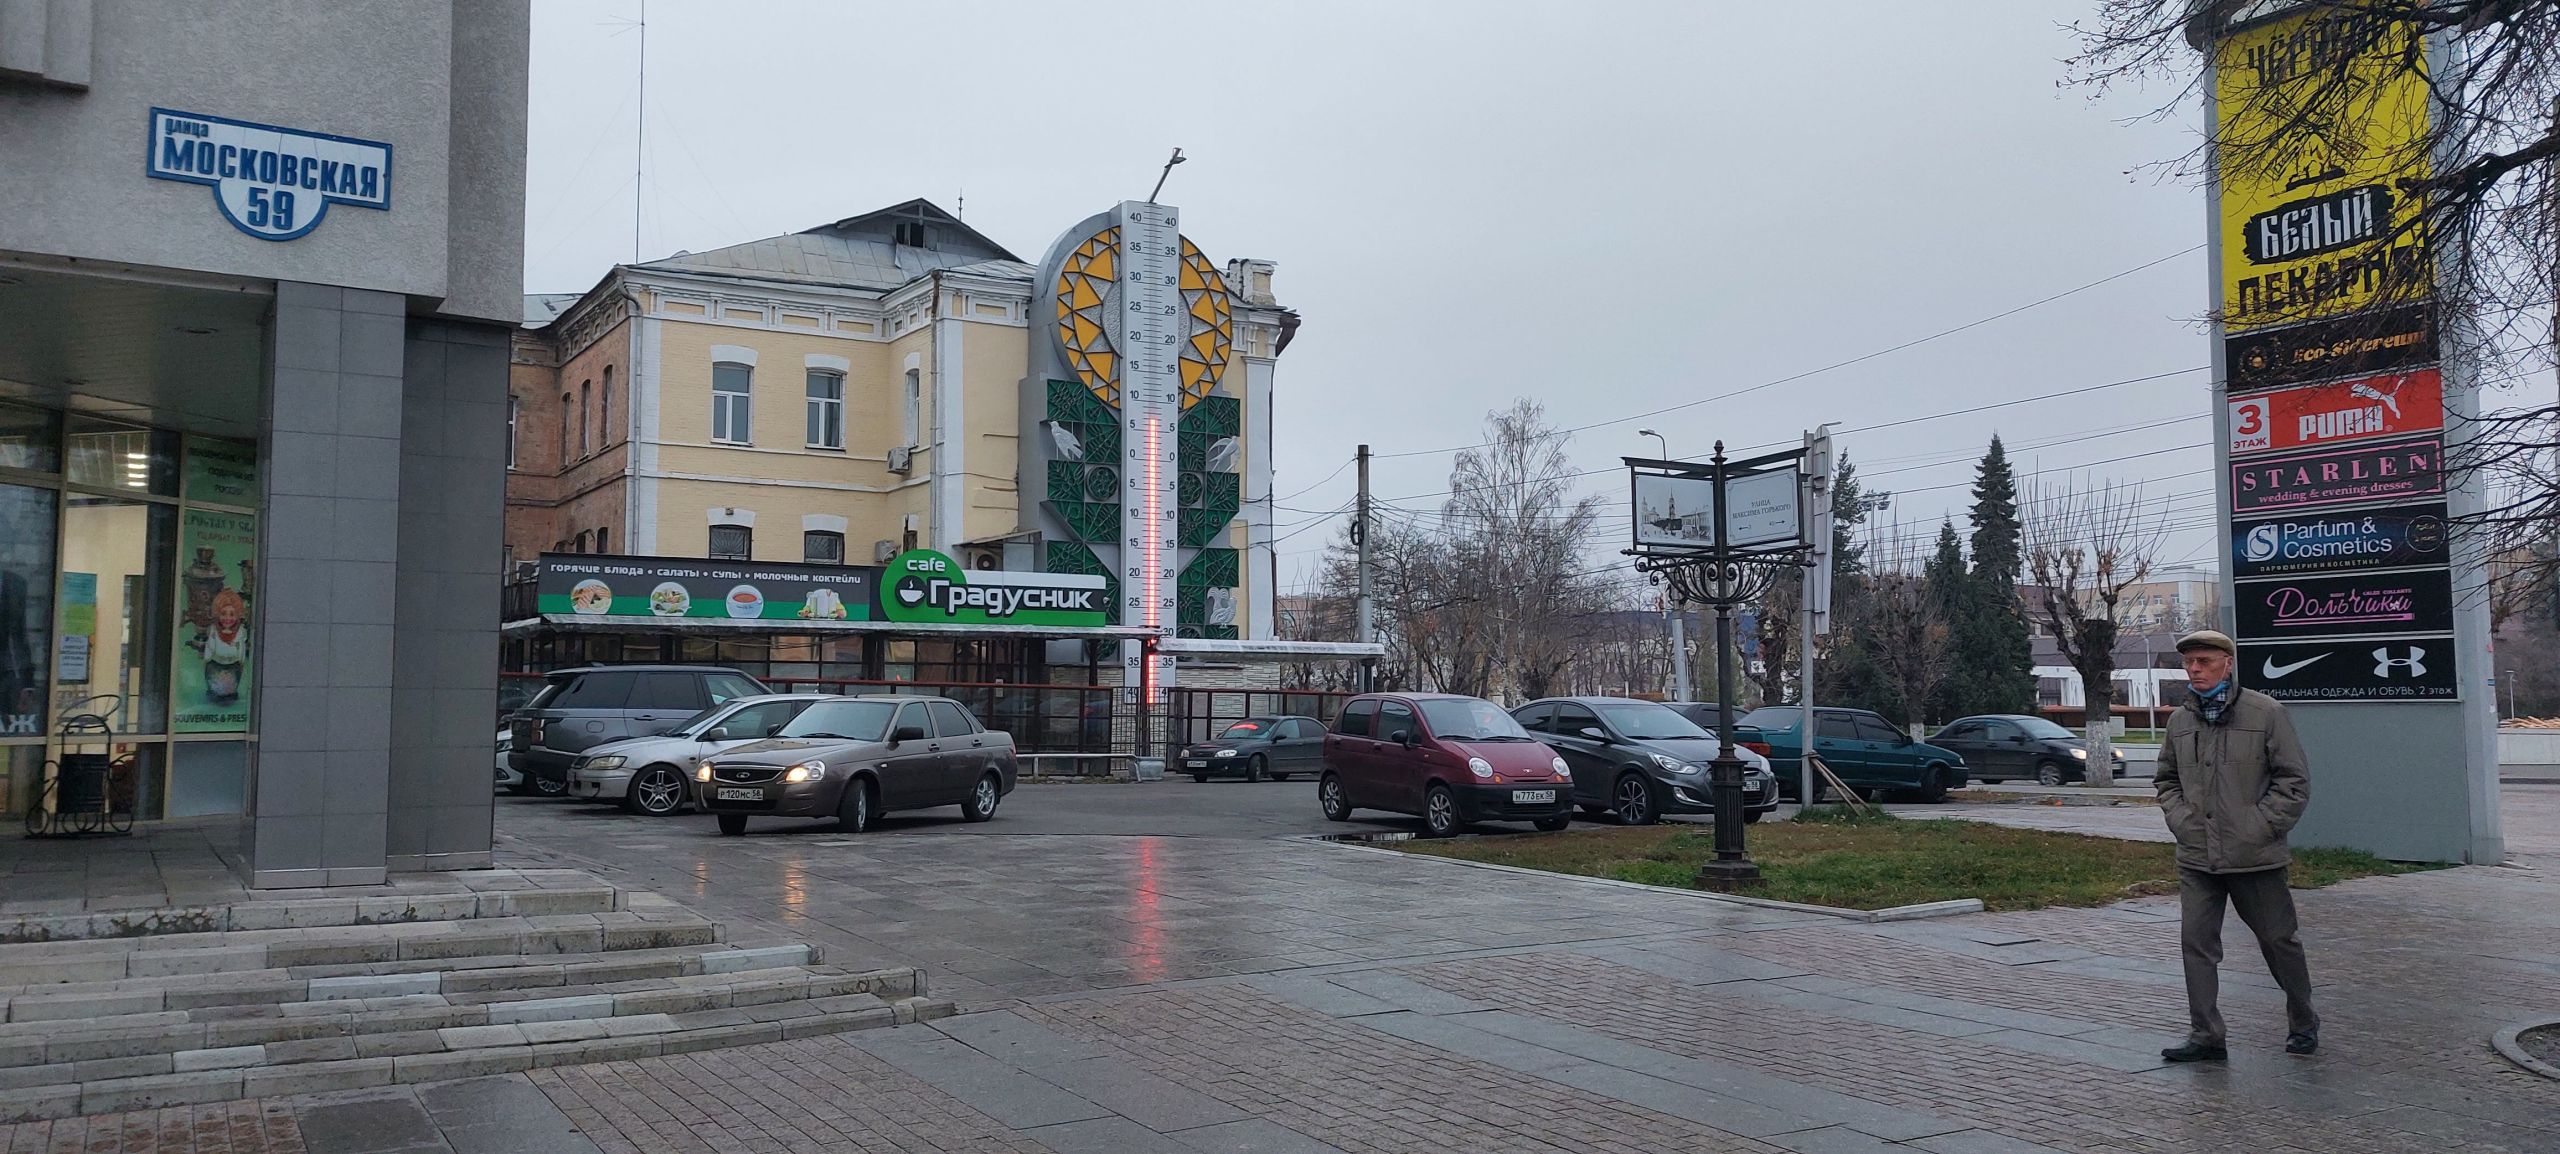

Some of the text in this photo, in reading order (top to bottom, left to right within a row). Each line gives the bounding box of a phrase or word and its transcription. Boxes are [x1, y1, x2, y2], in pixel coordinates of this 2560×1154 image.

[165, 118, 209, 138] улица
[163, 137, 378, 198] МОСКОВСКАЯ
[247, 186, 295, 230] 59
[1130, 212, 1177, 226] 40 40
[1130, 242, 1176, 255] 35 35
[1130, 271, 1176, 285] 30 30
[1130, 301, 1176, 314] 25 25
[1130, 331, 1176, 344] 20 20
[1130, 361, 1175, 373] 15 15
[1130, 390, 1175, 402] 10 10
[1130, 420, 1175, 432] 5 5
[2238, 404, 2262, 435] 3
[2299, 406, 2384, 441] PUMA
[2233, 437, 2267, 449] ЭТАЖ
[1130, 449, 1175, 461] 0 0
[2242, 453, 2428, 492] STARLEN
[1130, 479, 1175, 490] 5 5
[2258, 480, 2413, 503] wedding & evening dresses
[1130, 508, 1175, 519] 10 10
[2284, 516, 2377, 540] Parfum &
[1129, 538, 1174, 548] 15 15
[2284, 536, 2393, 559] Cosmetics
[906, 557, 945, 572] cafe
[2327, 559, 2380, 567] КОСМЕТИКА
[1129, 568, 1174, 577] 20 20
[930, 580, 1093, 615] Градусник
[1129, 597, 1174, 607] 25 25
[2266, 587, 2413, 618] Дольчики
[1128, 657, 1173, 666] 35 35
[2321, 687, 2365, 697] ОДЕЖДА
[2368, 688, 2376, 696] И
[2419, 685, 2425, 695] 2
[2429, 687, 2452, 695] этаж
[0, 714, 36, 732] Ж
